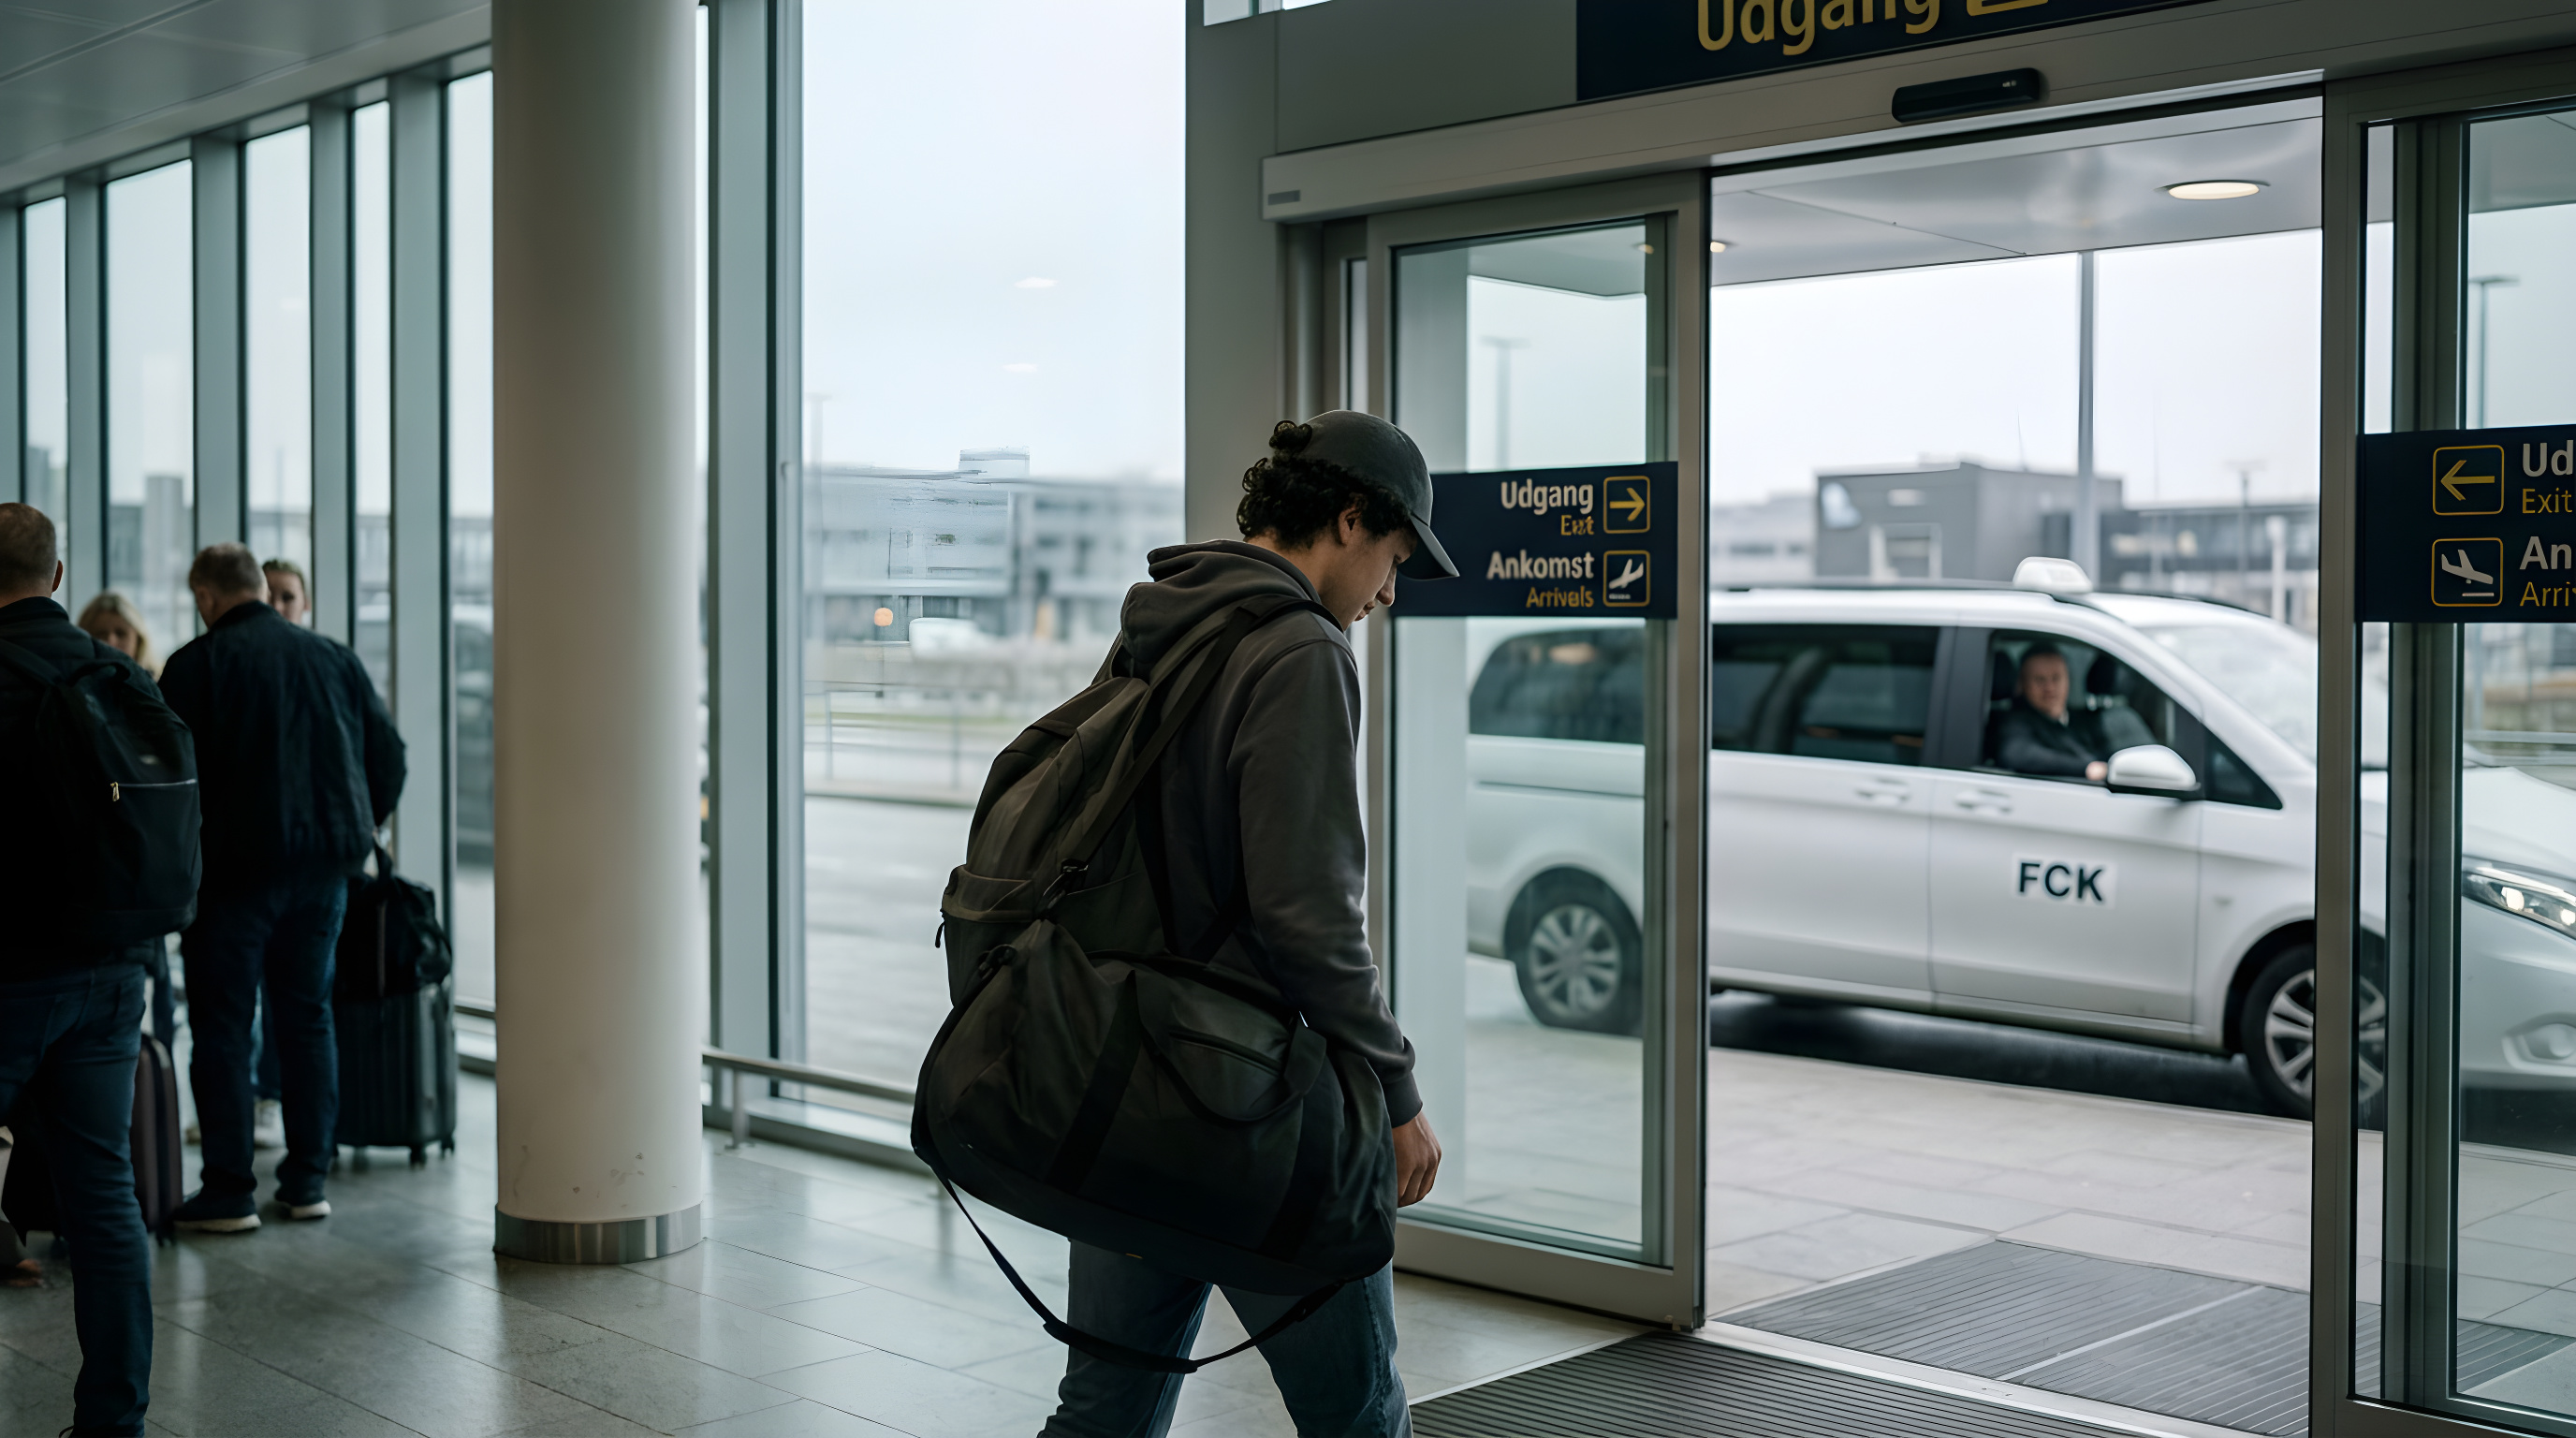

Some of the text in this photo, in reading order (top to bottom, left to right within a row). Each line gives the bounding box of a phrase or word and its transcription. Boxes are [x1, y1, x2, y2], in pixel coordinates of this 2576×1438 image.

[1500, 478, 1593, 515] Udgang
[2522, 487, 2573, 514] Exit
[1486, 550, 1594, 580] Ankomst
[1526, 585, 1594, 609] Arrivals
[2018, 862, 2103, 902] FCK
